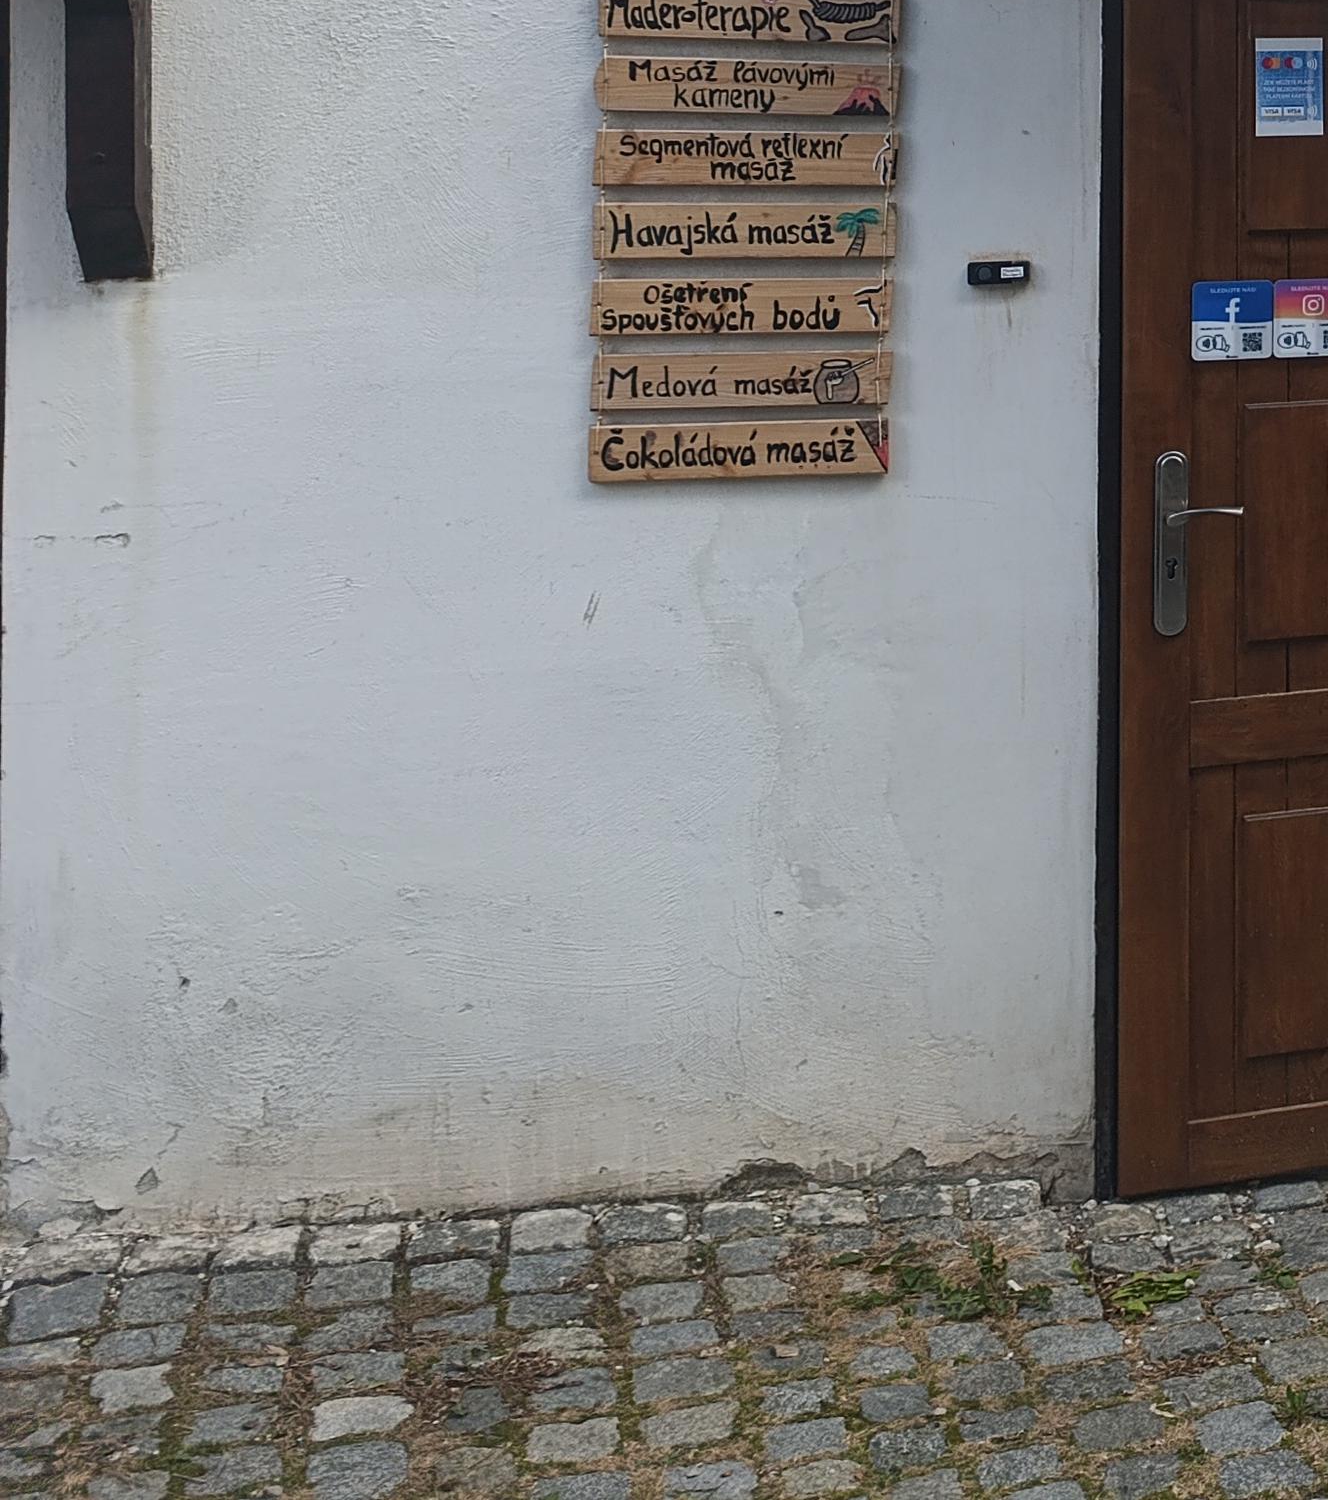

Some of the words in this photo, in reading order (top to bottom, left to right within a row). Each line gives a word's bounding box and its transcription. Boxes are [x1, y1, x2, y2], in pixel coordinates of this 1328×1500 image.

[628, 59, 717, 83] Masáž
[733, 60, 836, 90] lávovými
[673, 84, 775, 112] kameny
[619, 132, 755, 163] Segmentová
[761, 132, 849, 159] reflexní
[710, 156, 797, 182] masáž
[609, 209, 738, 255] Havajská
[749, 215, 835, 245] masáž
[644, 281, 753, 304] Ošetření
[772, 296, 841, 330] bodů
[607, 365, 718, 400] Medová
[734, 366, 814, 395] masáž
[601, 428, 757, 472] Čokoládová
[766, 426, 857, 463] masáž
